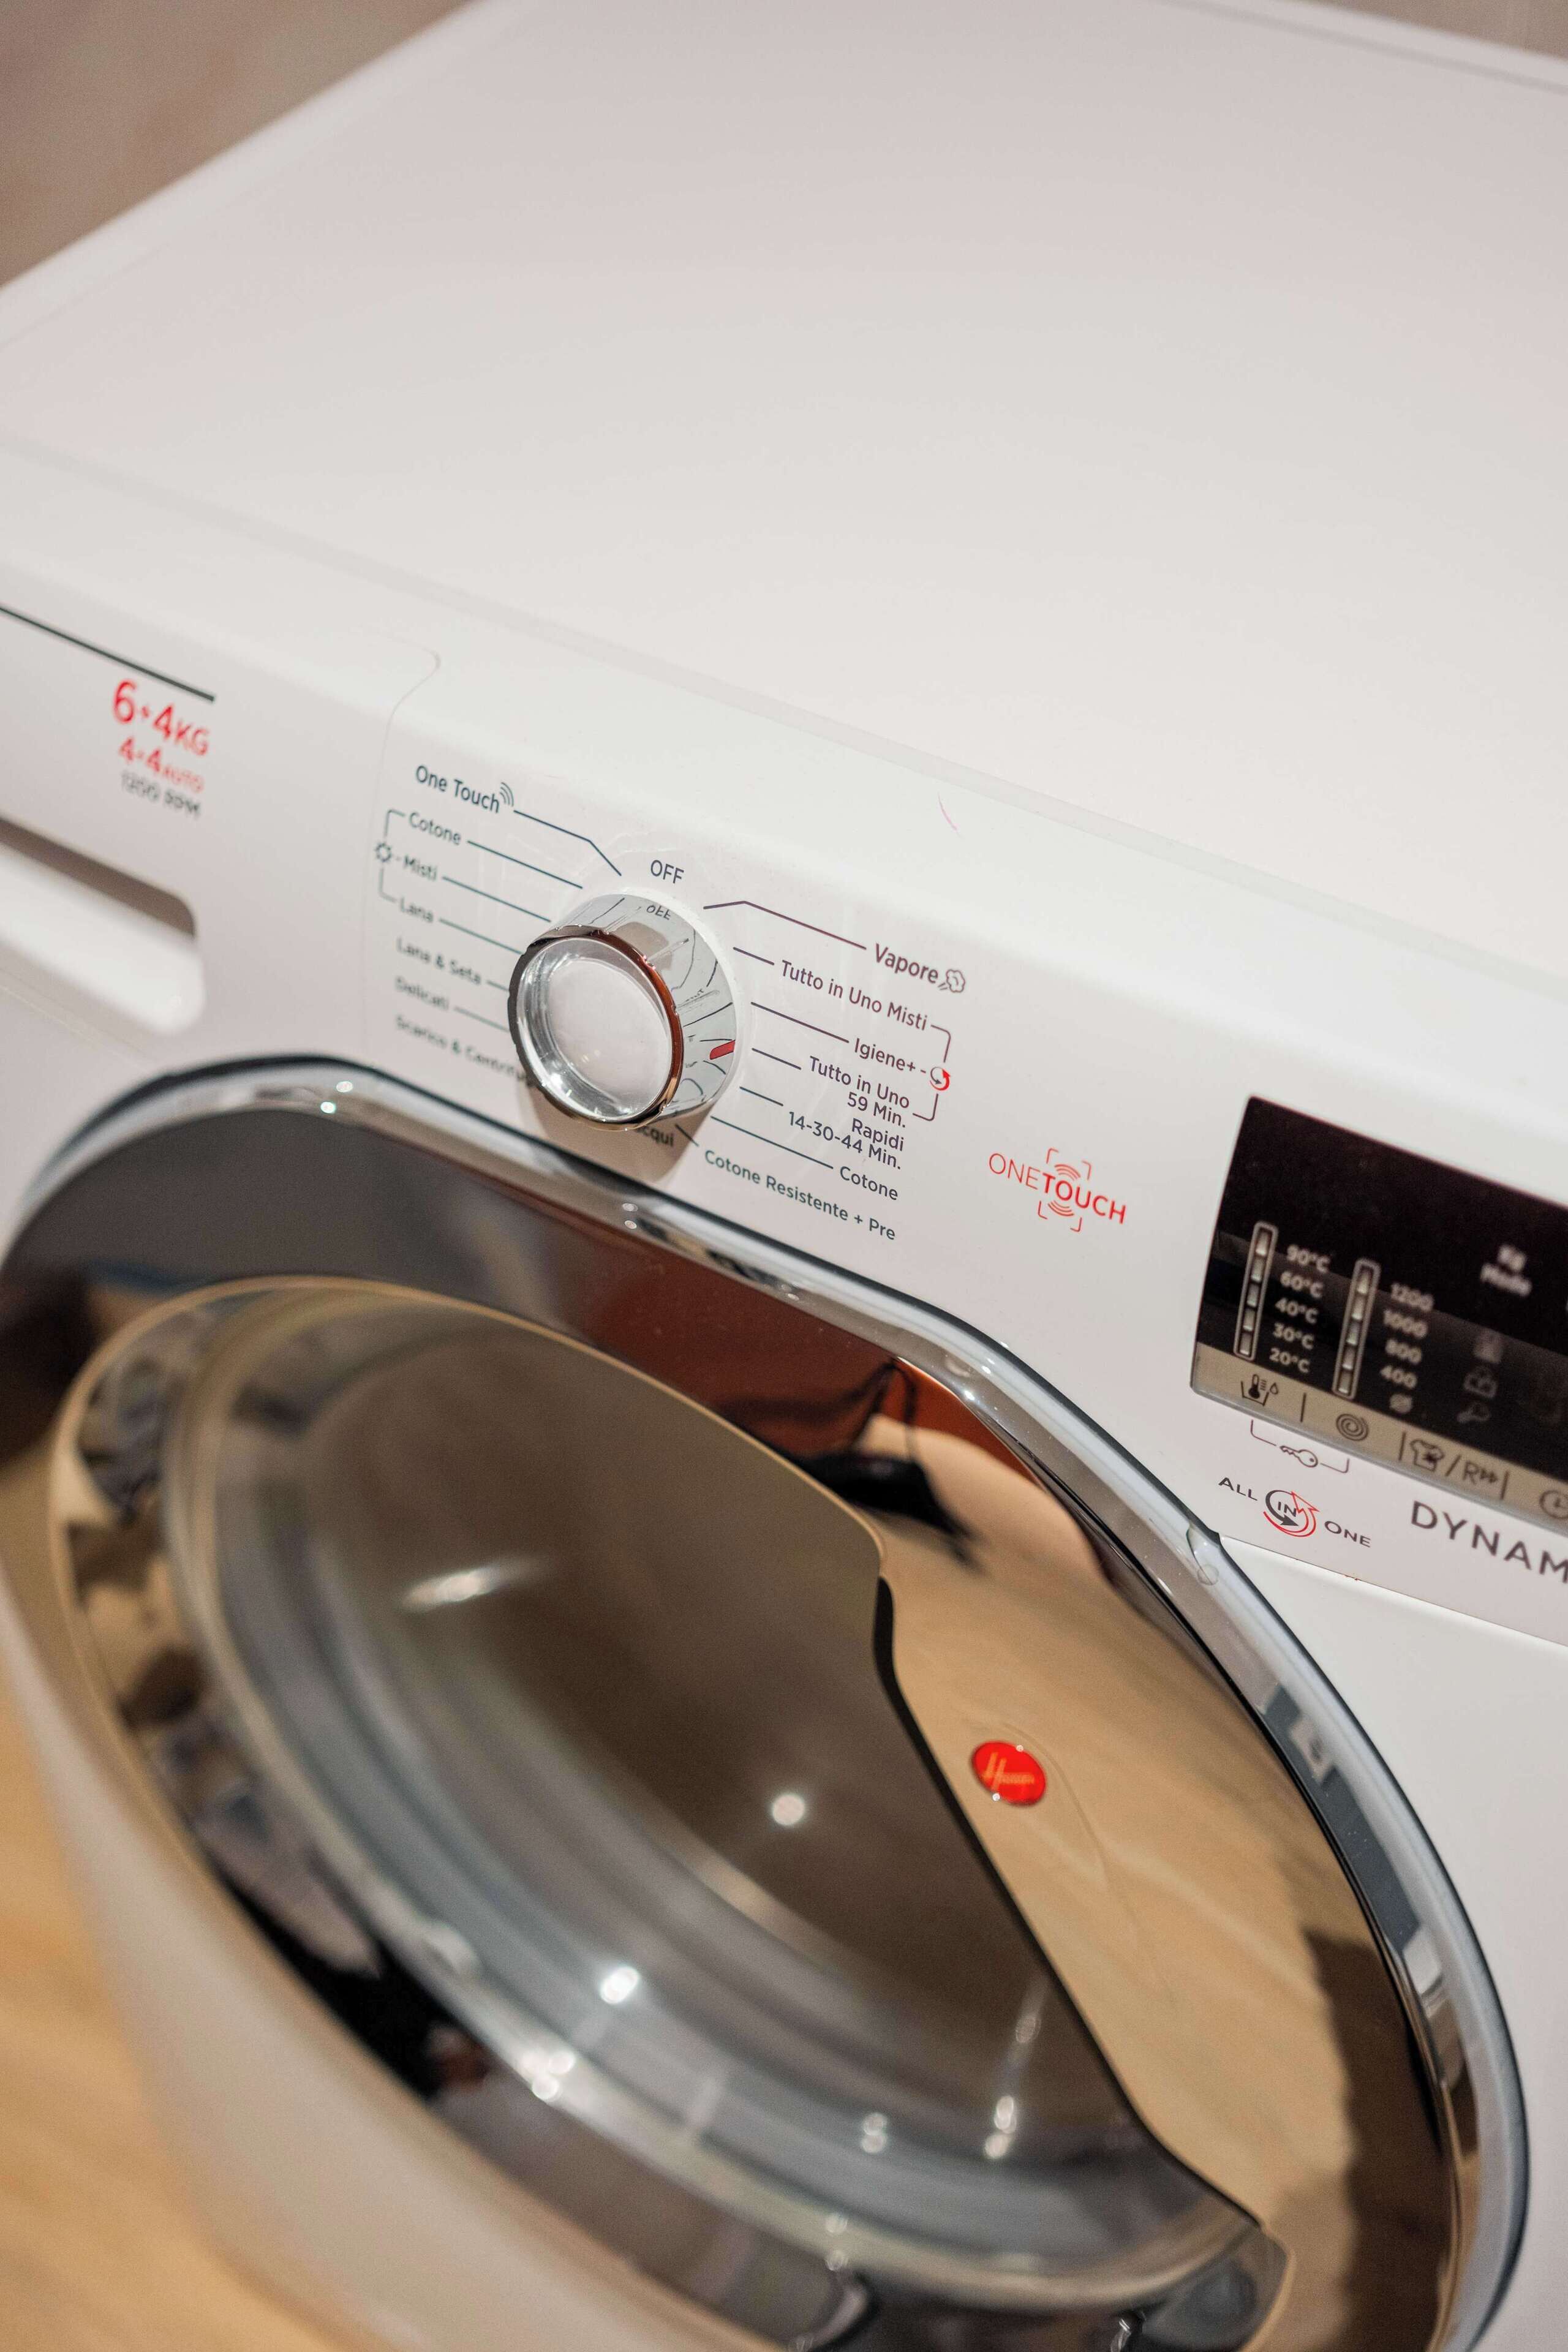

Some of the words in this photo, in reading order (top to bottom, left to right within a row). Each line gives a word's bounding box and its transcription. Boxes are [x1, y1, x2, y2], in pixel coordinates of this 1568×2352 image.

[416, 765, 448, 792] One
[454, 779, 500, 814] Touch
[409, 812, 462, 846] Cotone
[404, 855, 438, 881] Misti
[650, 859, 684, 884] OFF
[399, 897, 434, 923] Lana
[397, 936, 431, 964] Lana
[435, 954, 445, 970] &
[450, 957, 482, 986] Seta
[875, 943, 939, 984] Vapore
[396, 976, 449, 1011] Delicati
[782, 960, 823, 990] Tutto
[828, 979, 843, 998] in
[849, 987, 882, 1012] Uno
[888, 1002, 927, 1030] Misti
[396, 1014, 448, 1049] Scarico
[452, 1041, 461, 1055] &
[854, 1038, 916, 1072] Igiene+
[810, 1055, 851, 1085] Tutto
[857, 1075, 871, 1094] in
[877, 1084, 910, 1109] Uno
[847, 1091, 868, 1111] 59
[873, 1102, 906, 1128] Min.
[789, 1112, 862, 1153] 14-30-44
[869, 1144, 901, 1169] Min.
[851, 1118, 904, 1152] Rapidi
[704, 1150, 761, 1184] Cotone
[766, 1175, 848, 1221] Resistente
[854, 1215, 863, 1224] +
[869, 1218, 895, 1240] Pre
[840, 1166, 898, 1200] Cotone
[1275, 1297, 1319, 1324] 40°C
[1272, 1321, 1314, 1350] 30°C
[1268, 1348, 1311, 1374] 20°C
[1379, 1365, 1418, 1390] 400
[1218, 1477, 1257, 1501] ALL
[1278, 1501, 1297, 1517] IN
[1325, 1521, 1371, 1548] ONE
